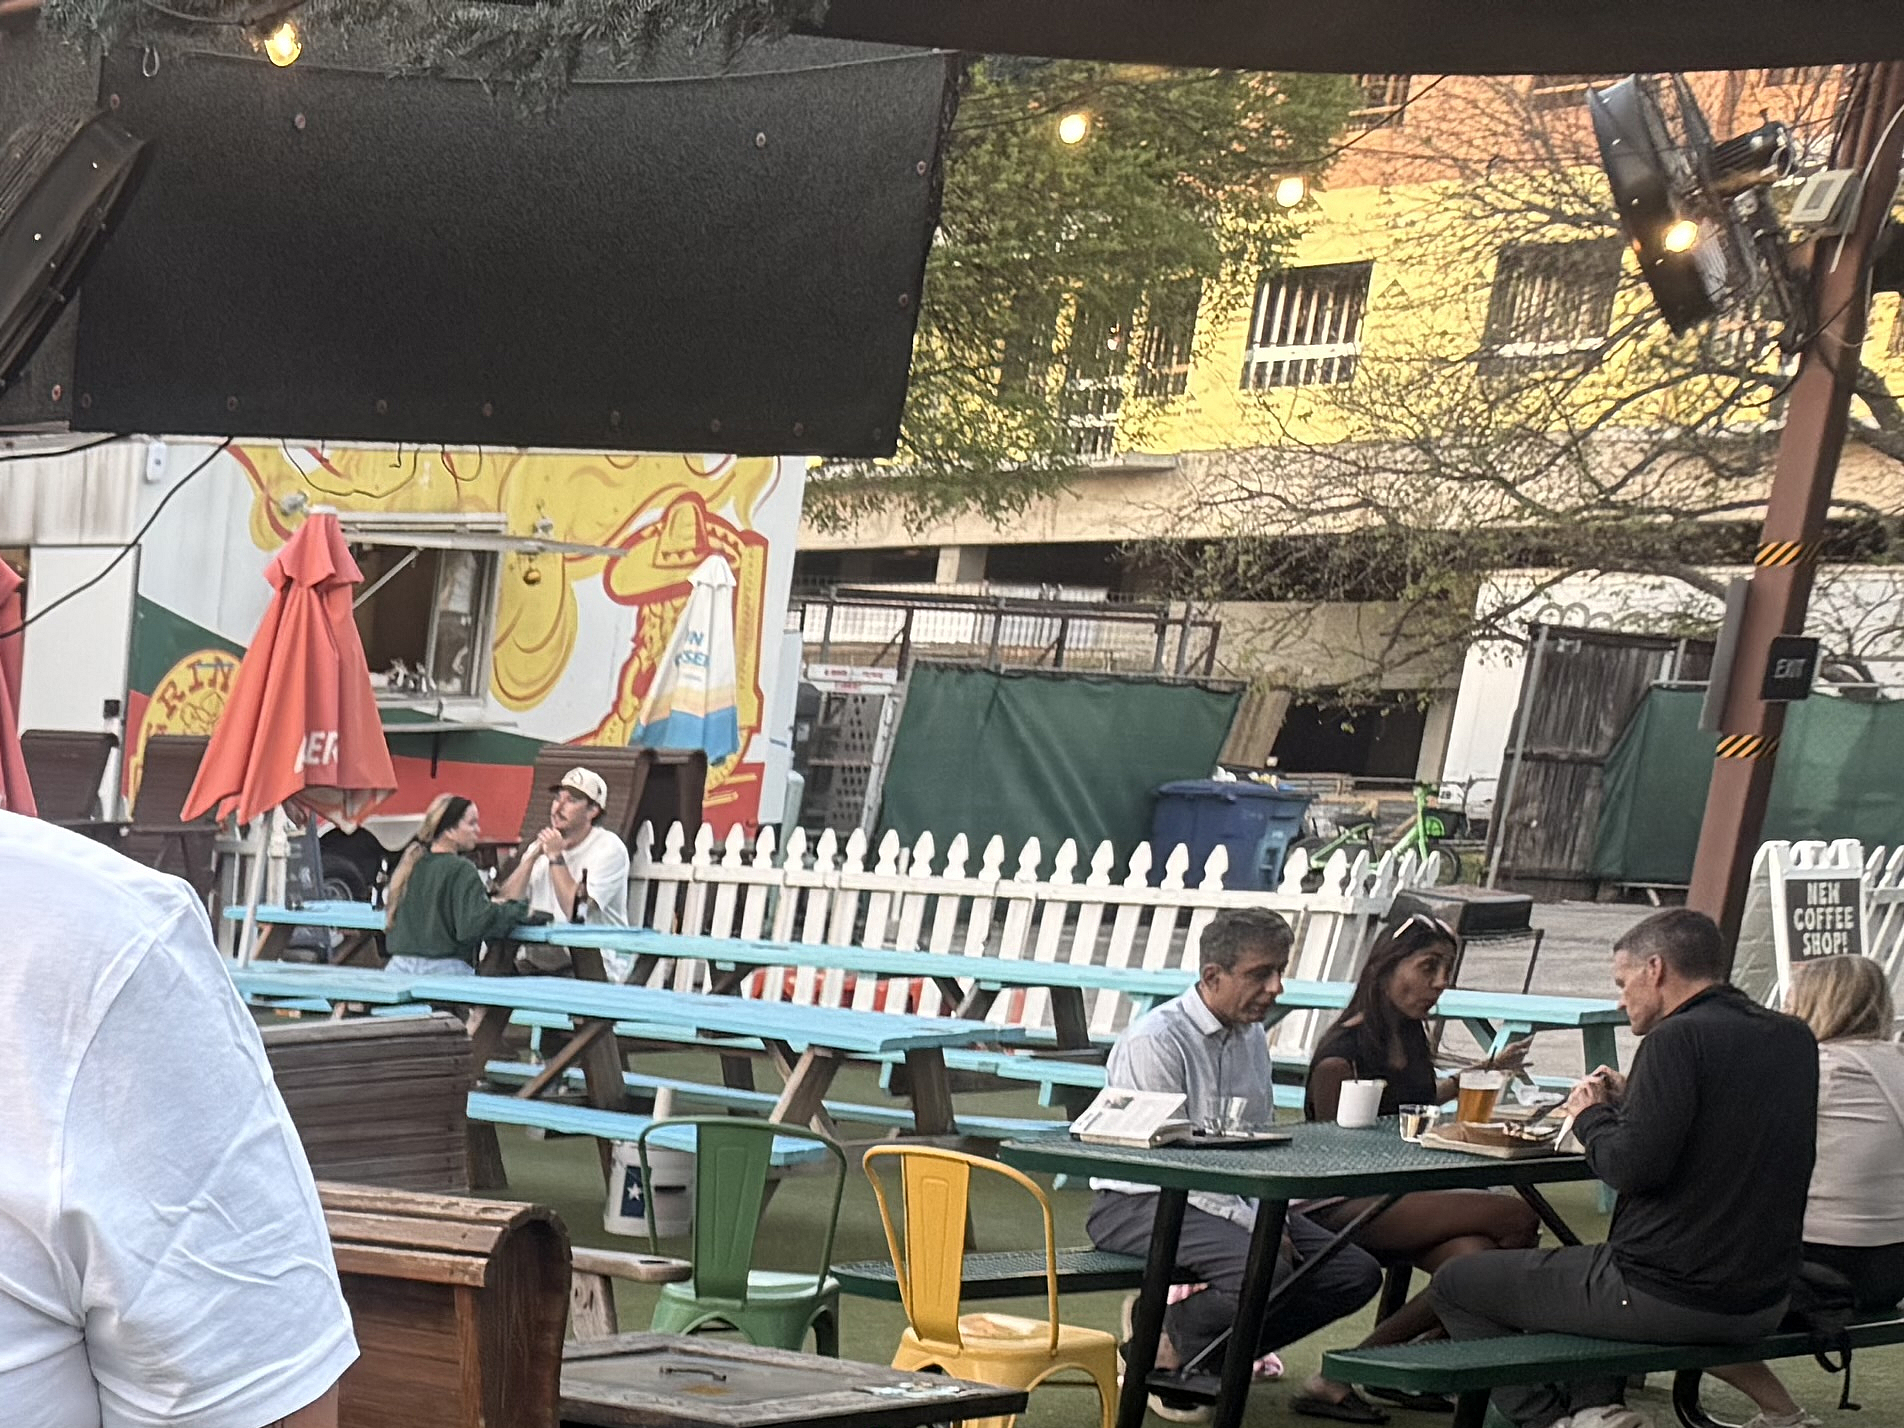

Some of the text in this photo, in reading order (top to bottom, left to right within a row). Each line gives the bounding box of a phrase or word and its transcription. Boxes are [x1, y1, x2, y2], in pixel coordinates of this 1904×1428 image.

[1807, 881, 1841, 905] NEW
[1793, 906, 1854, 931] COFFEE
[1803, 931, 1849, 956] SHOP!
